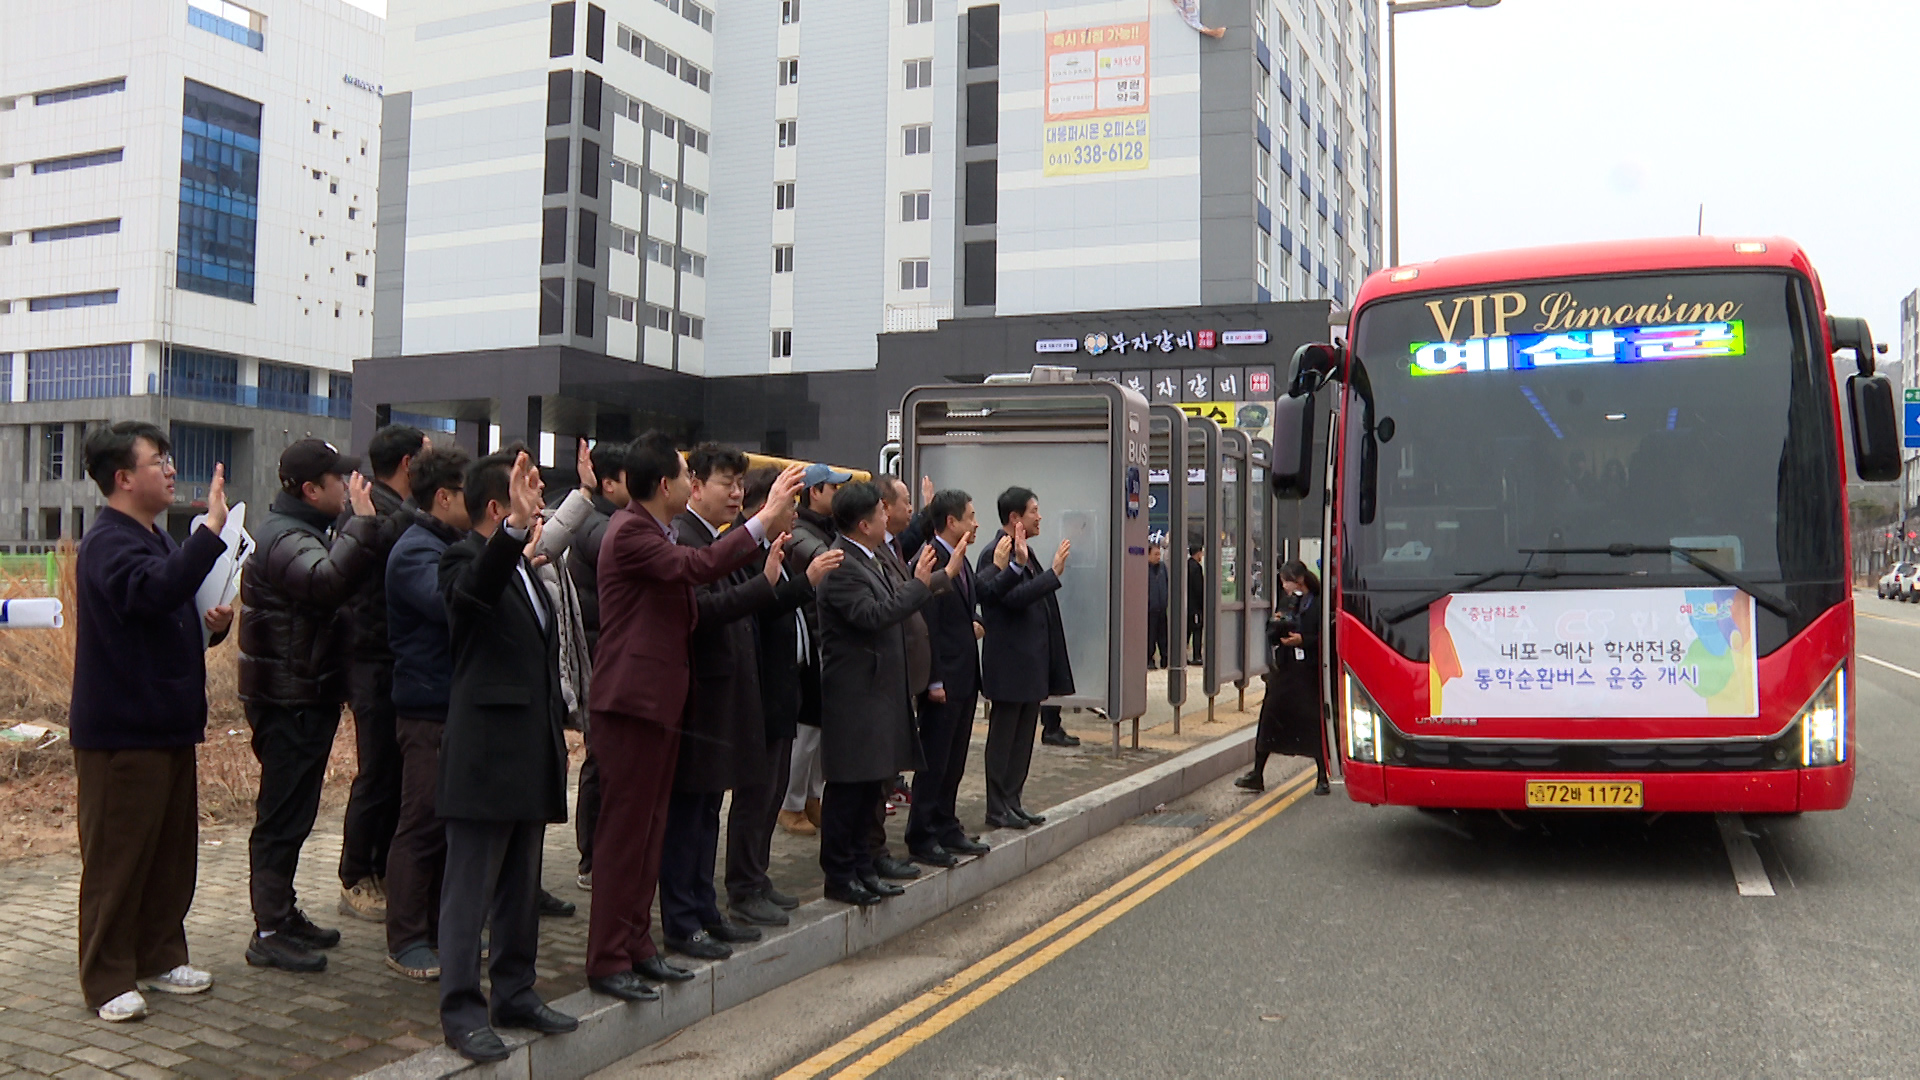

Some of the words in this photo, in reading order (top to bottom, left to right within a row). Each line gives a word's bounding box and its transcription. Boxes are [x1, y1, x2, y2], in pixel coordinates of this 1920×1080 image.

[1074, 140, 1144, 165] 338-6128
[1425, 291, 1527, 341] VIP
[1533, 290, 1744, 332] Limousine
[1110, 329, 1195, 354] 부자갈비
[1128, 440, 1148, 466] BUS
[1500, 641, 1595, 664] 내포-예산
[1605, 639, 1686, 664] 학생전용
[1474, 667, 1596, 691] 통학순환버스
[1605, 666, 1648, 690] 운송
[1657, 665, 1698, 686] 개시
[1546, 785, 1581, 803] 72바
[1587, 785, 1634, 804] 1172
